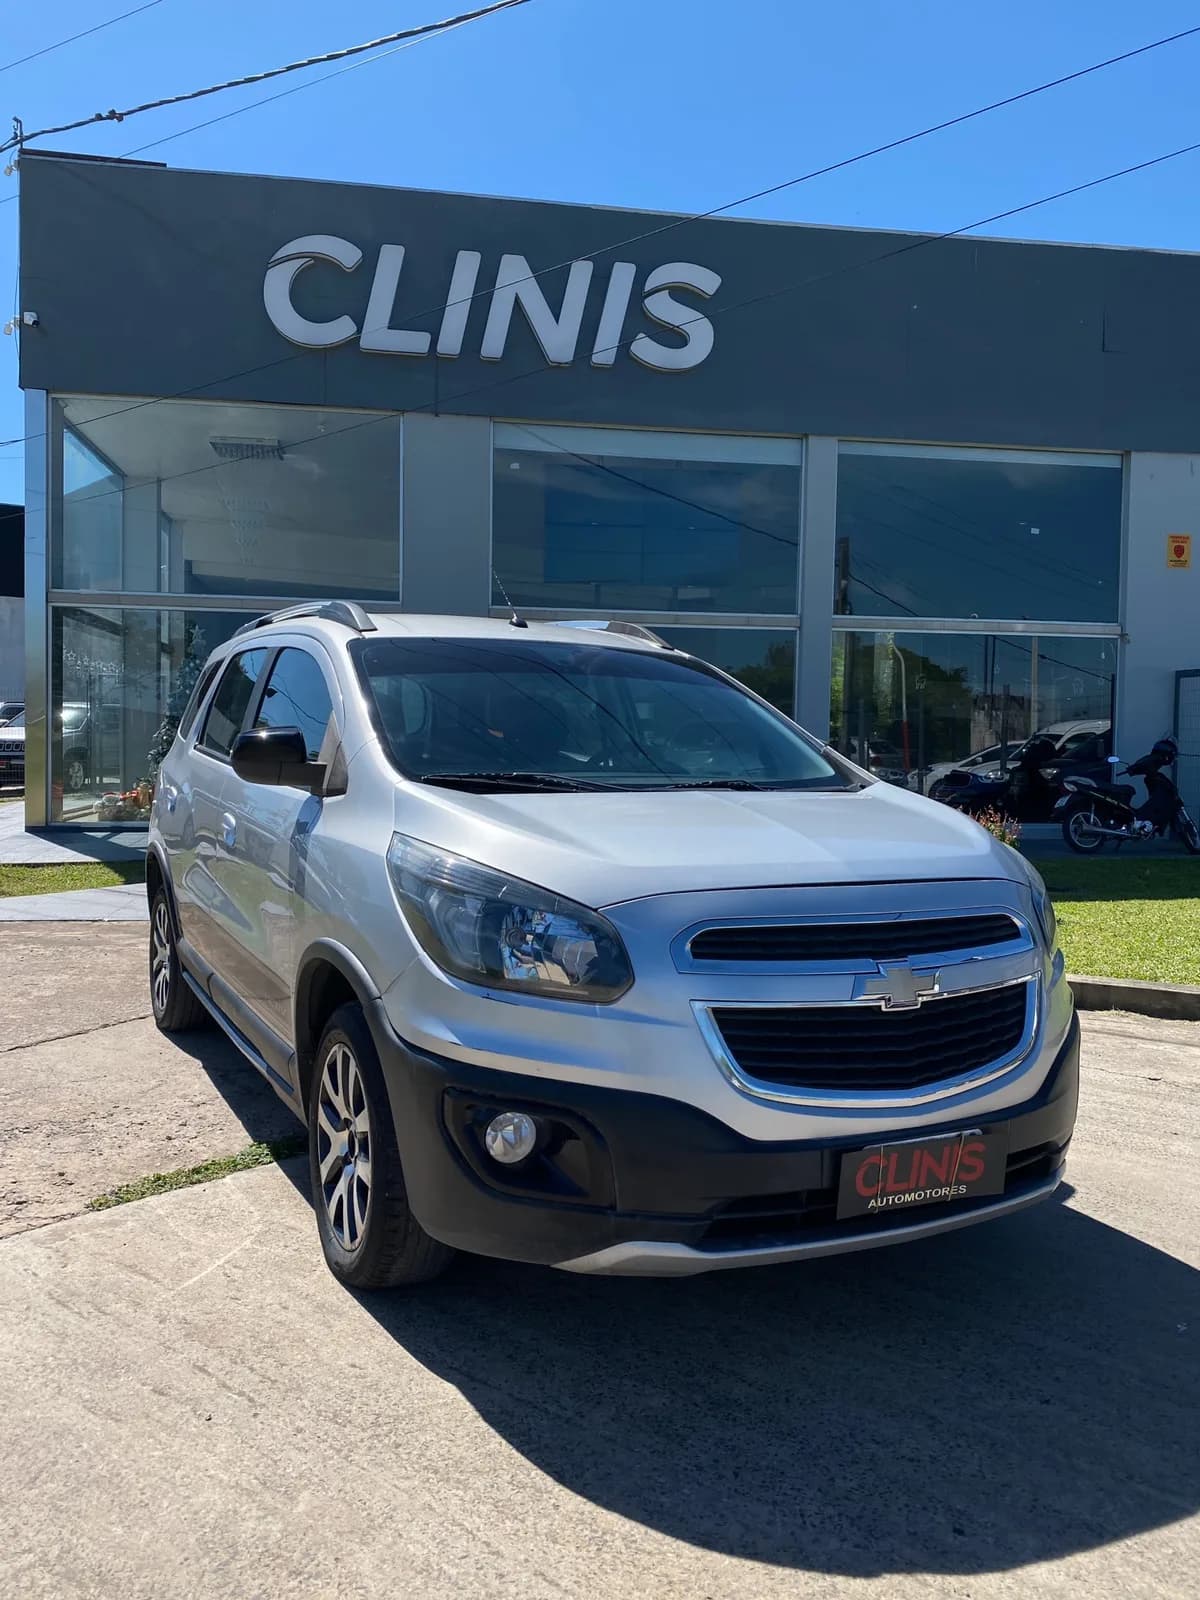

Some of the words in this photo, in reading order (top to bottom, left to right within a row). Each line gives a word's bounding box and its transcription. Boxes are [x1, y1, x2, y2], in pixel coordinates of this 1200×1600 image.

[263, 234, 722, 373] CLINIS
[856, 1142, 986, 1197] CLINIS
[868, 1185, 967, 1209] AUTOMOTORES
